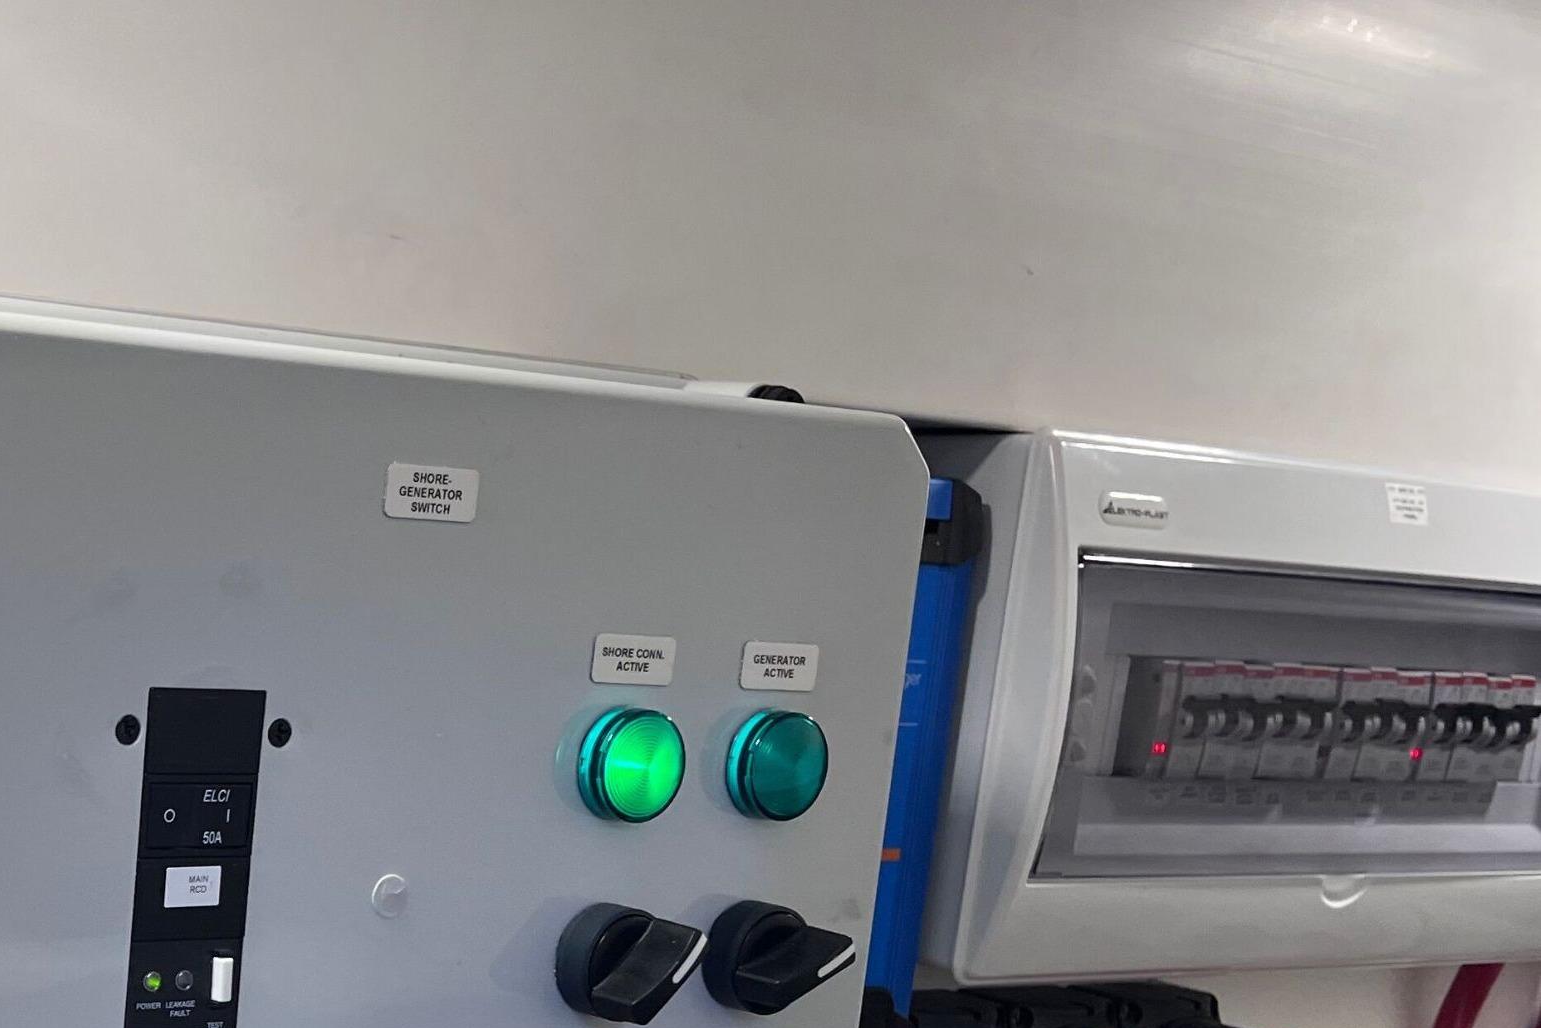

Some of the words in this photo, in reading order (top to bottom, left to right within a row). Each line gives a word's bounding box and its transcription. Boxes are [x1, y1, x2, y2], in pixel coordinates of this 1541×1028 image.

[412, 472, 452, 485] SHORE-
[399, 485, 463, 501] GENERATOR
[410, 502, 451, 515] SWITCH
[602, 646, 634, 659] SHORE
[636, 648, 665, 660] CONN.
[753, 654, 806, 666] GENERATOR
[616, 661, 649, 673] ACTIVE
[763, 668, 794, 679] ACTIVE
[203, 789, 230, 802] ELCI
[202, 831, 222, 844] 50A
[188, 875, 208, 884] MAIN
[190, 885, 207, 894] RCD
[136, 1002, 162, 1010] POWER
[165, 1000, 196, 1009] LEAKAGE
[169, 1009, 192, 1018] FAULT
